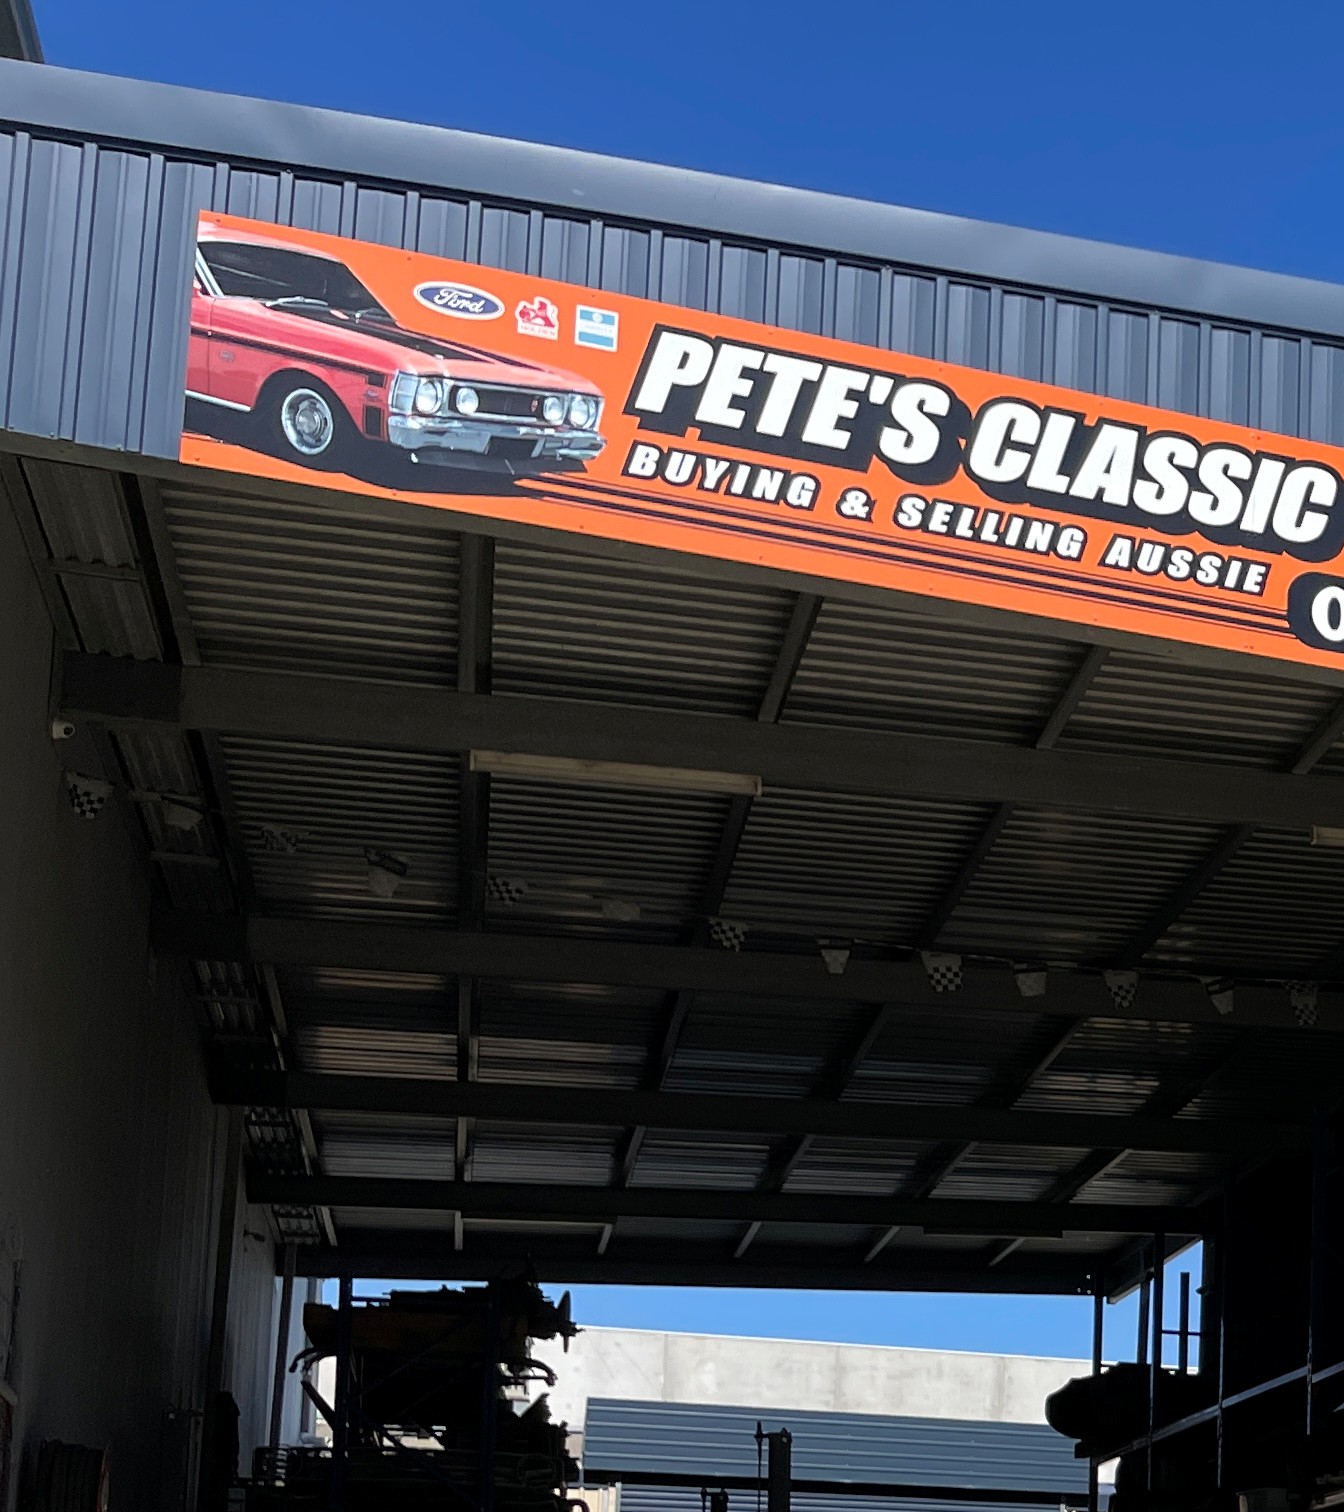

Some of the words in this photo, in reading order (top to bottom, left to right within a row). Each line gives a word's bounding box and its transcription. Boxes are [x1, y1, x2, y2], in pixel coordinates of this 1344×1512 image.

[434, 288, 484, 314] Ford
[635, 328, 951, 467] PETE'S
[969, 400, 1338, 543] CLASSIC
[628, 446, 817, 511] BUYING
[838, 488, 873, 521] &
[899, 495, 1085, 560] SELLING
[1104, 537, 1268, 595] AUSSIE
